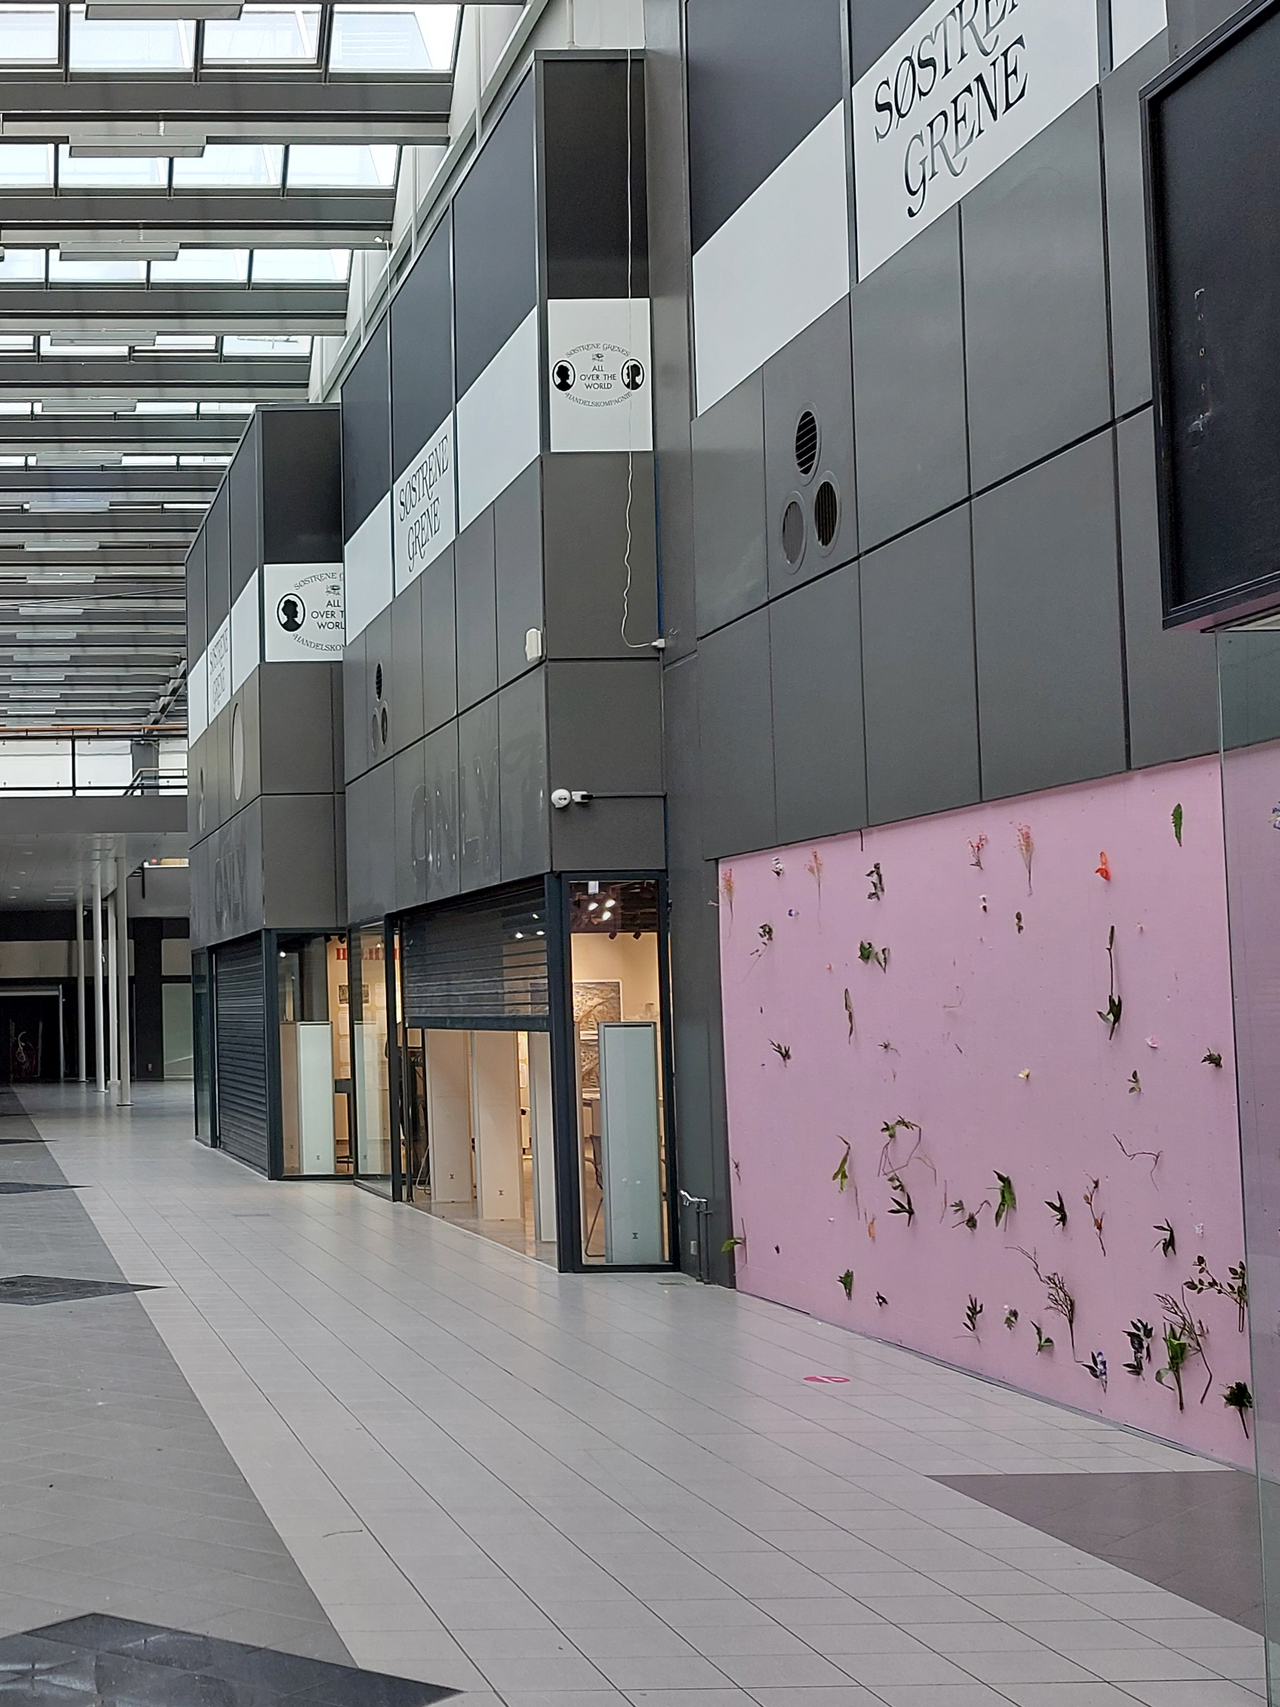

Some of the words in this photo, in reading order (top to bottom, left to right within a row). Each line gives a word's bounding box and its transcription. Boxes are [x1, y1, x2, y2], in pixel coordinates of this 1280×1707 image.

[874, 0, 1018, 142] SØSTRE
[903, 34, 1028, 218] GRENE
[584, 382, 612, 390] WORLD
[407, 496, 441, 573] GRENE
[326, 600, 341, 608] ALL
[311, 610, 336, 619] OVER
[317, 621, 345, 630] WORL
[292, 633, 345, 652] HANDELSKO
